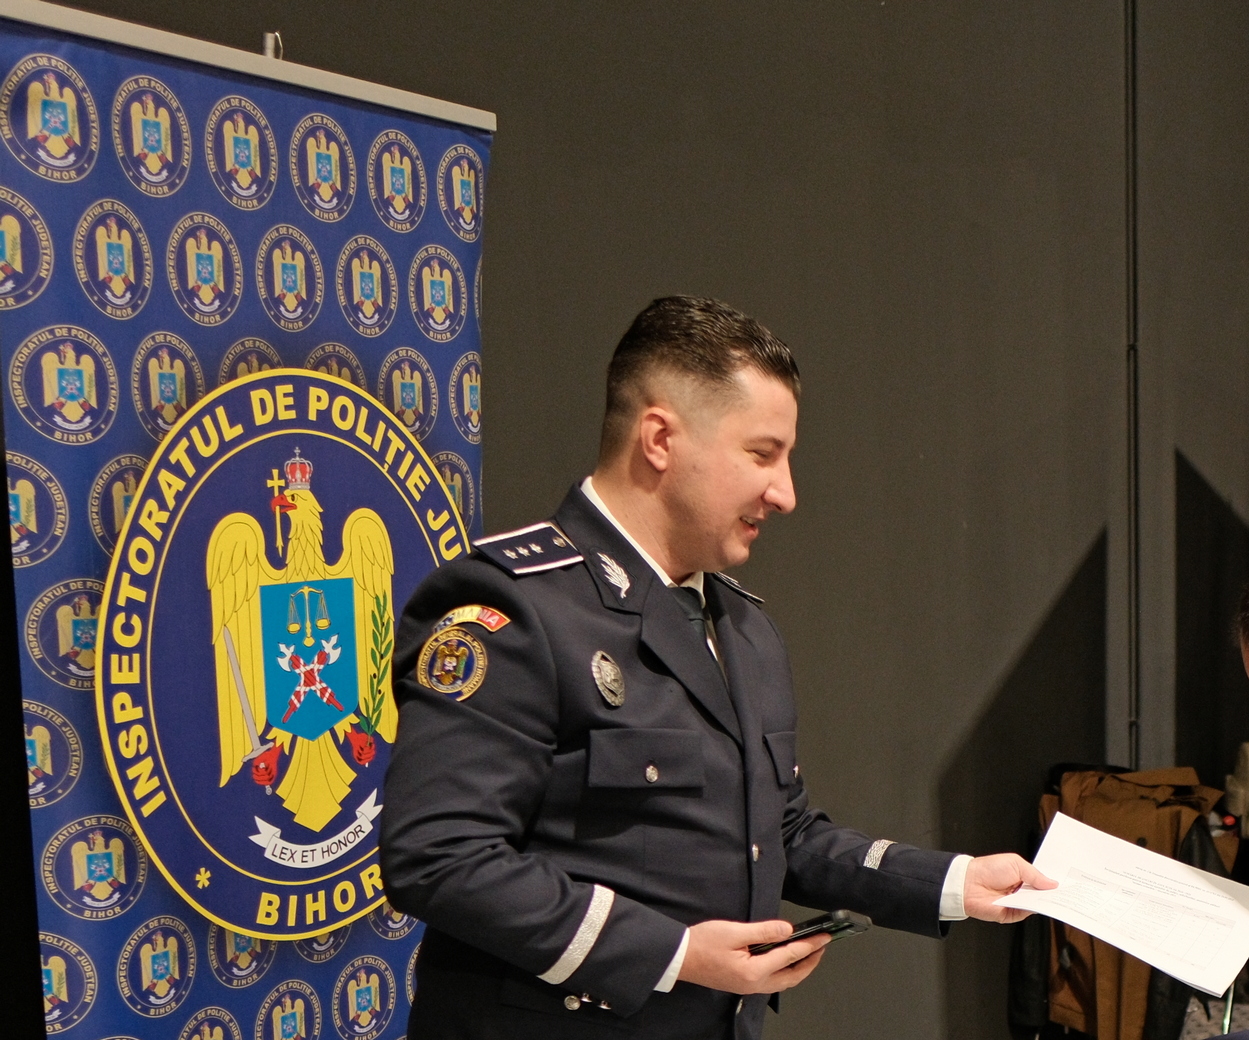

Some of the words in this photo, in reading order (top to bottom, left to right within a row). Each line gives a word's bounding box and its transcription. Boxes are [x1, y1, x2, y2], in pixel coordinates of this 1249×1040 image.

[38, 57, 50, 66] DE
[40, 166, 76, 180] BIHOR
[0, 192, 34, 218] OLITIE
[54, 328, 67, 336] DE
[54, 431, 93, 443] BIHOR
[111, 405, 243, 818] INSPECTORATUL
[250, 385, 297, 420] DE
[308, 386, 432, 503] POLIȚIE
[84, 818, 98, 826] DE
[271, 843, 297, 863] LEX
[301, 849, 317, 863] ET
[321, 824, 366, 859] HONOR
[256, 863, 384, 927] BIHOR
[84, 906, 122, 918] BIHOR
[149, 919, 158, 928] DE
[150, 1002, 176, 1014] BIHOR
